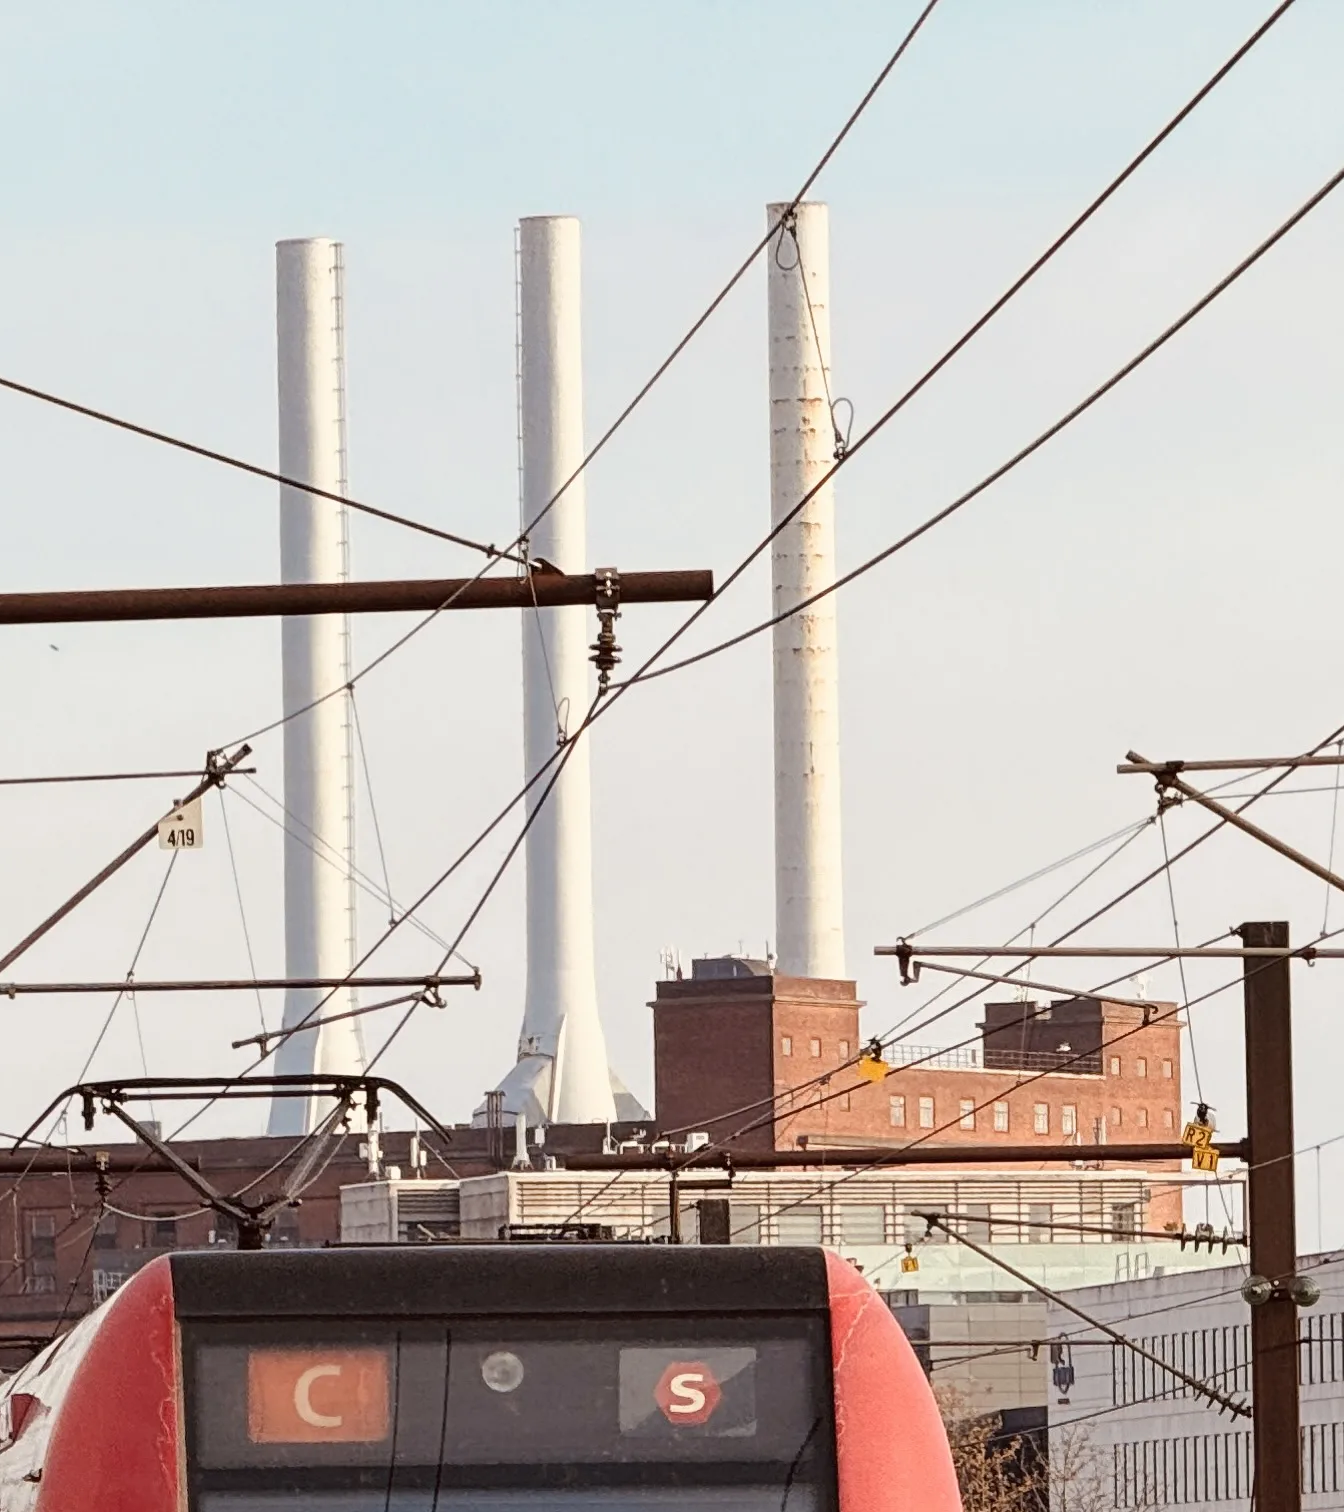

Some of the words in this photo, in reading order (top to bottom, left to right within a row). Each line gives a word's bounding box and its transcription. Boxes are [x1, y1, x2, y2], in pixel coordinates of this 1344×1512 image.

[167, 828, 195, 846] 4/19
[294, 1364, 342, 1428] C
[669, 1373, 706, 1413] S
